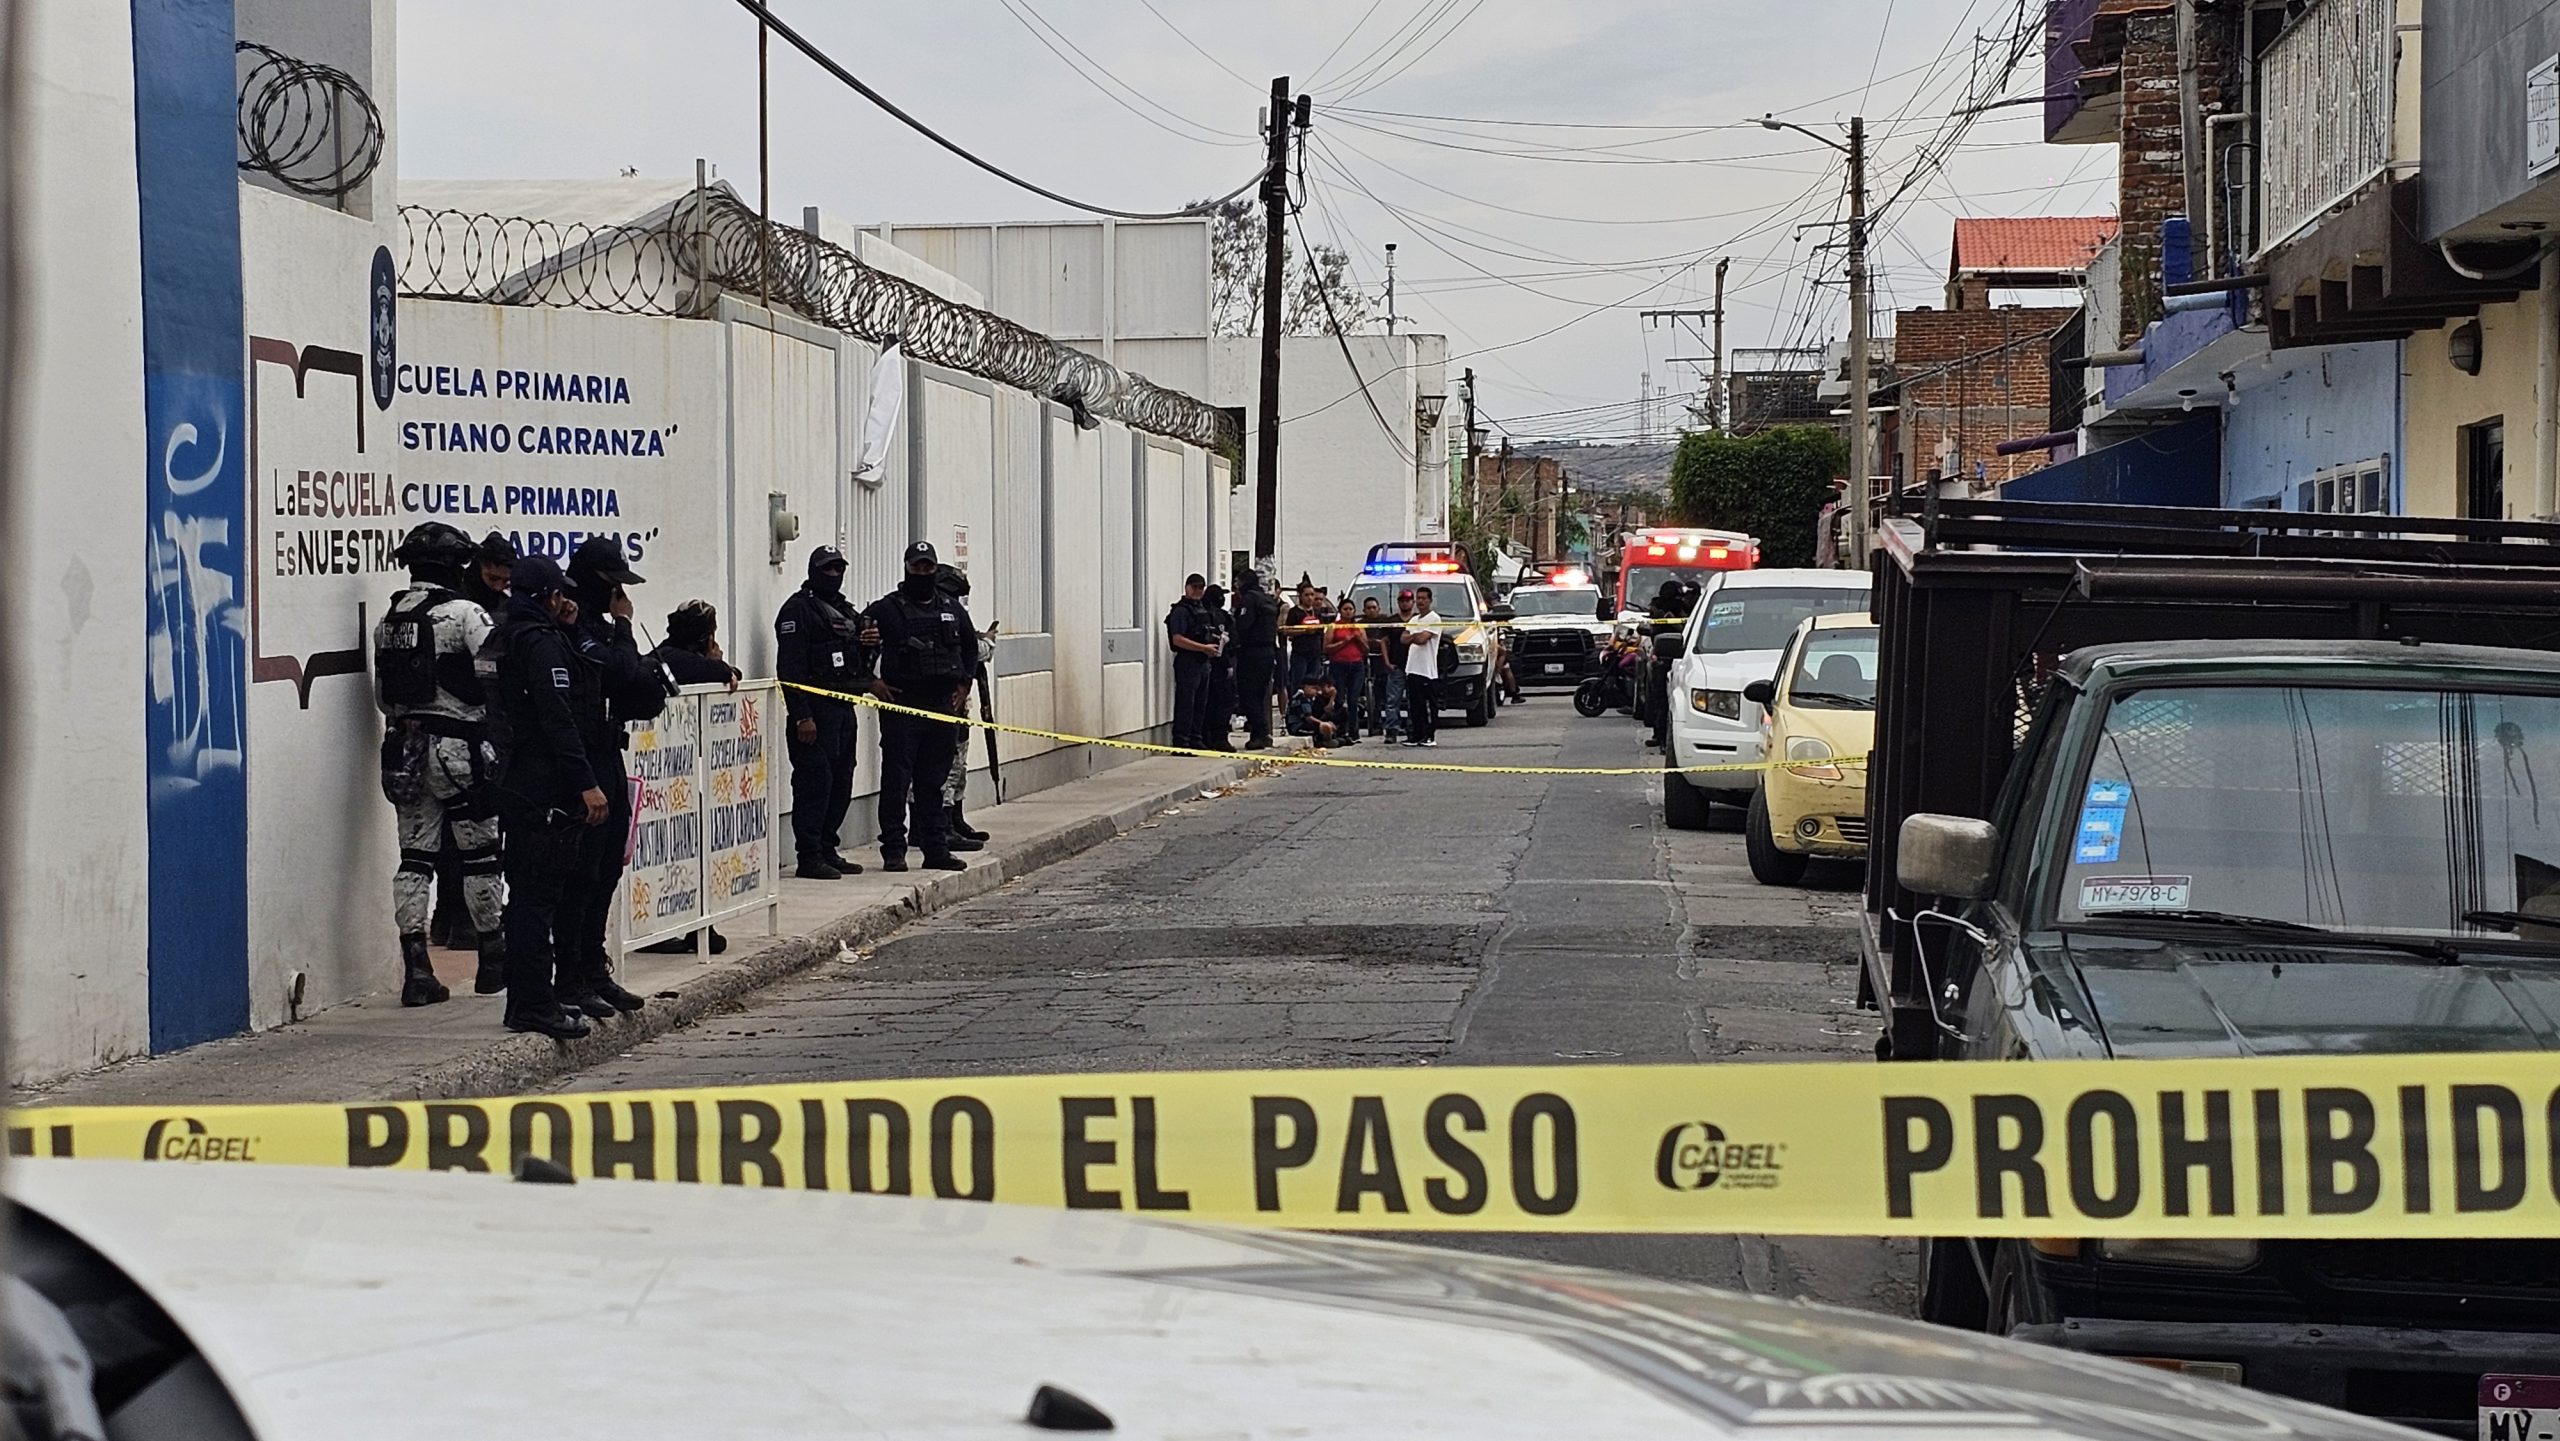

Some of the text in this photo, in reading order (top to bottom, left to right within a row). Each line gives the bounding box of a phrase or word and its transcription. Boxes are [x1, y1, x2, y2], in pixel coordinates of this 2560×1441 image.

[497, 370, 630, 404] PRIMARIA
[398, 421, 511, 454] STIANO
[505, 486, 620, 517] PRIMARIA
[634, 743, 693, 781] ESCUELA PRIMARIA
[711, 734, 762, 771] ESCUELA PRIMARIA
[2091, 886, 2178, 902] MY-7978-C
[1061, 1095, 1190, 1211] EL
[1251, 1092, 1578, 1217] PASO
[1679, 1143, 1782, 1170] CABEL
[1881, 1084, 2560, 1220] PROHIBID
[2489, 1409, 2560, 1441] MY-
